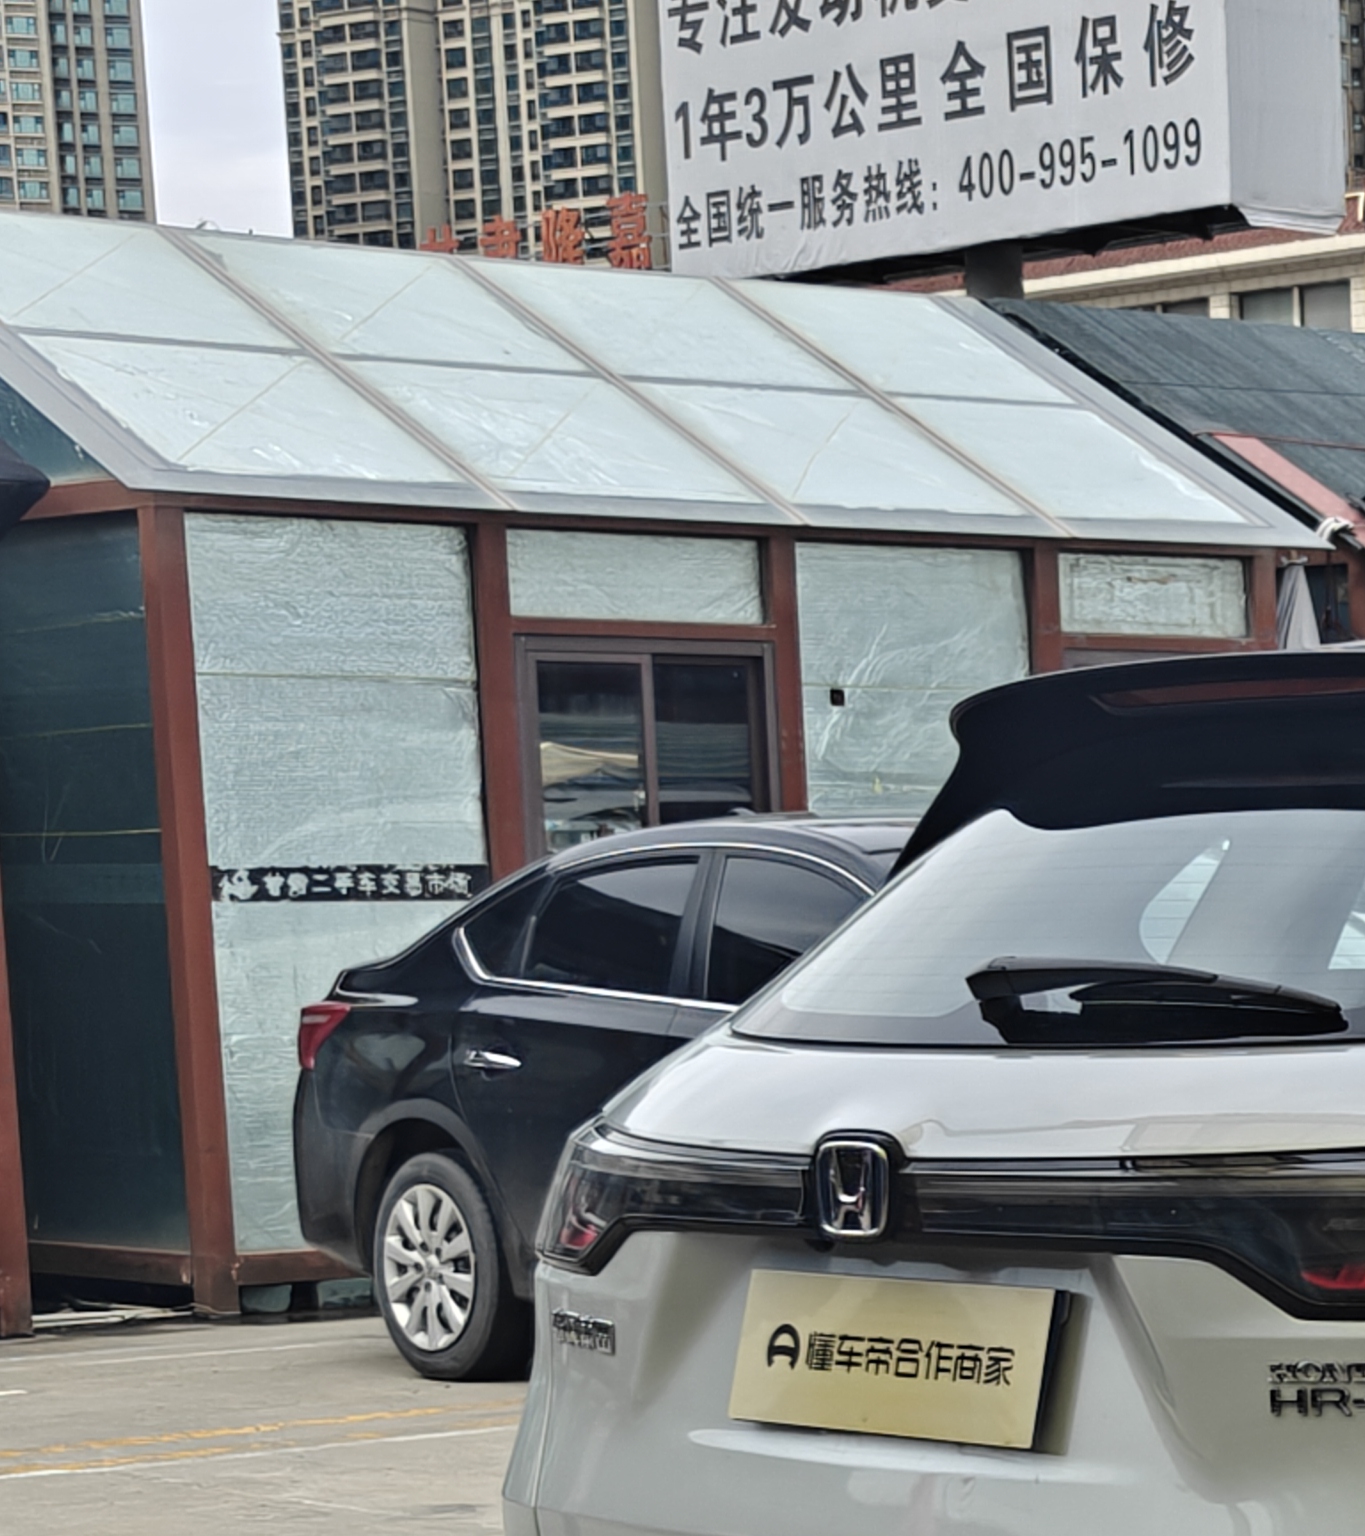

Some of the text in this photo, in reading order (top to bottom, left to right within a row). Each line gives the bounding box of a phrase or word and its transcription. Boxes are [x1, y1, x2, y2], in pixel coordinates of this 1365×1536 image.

[805, 1331, 1016, 1386] 懂车帝合作商家
